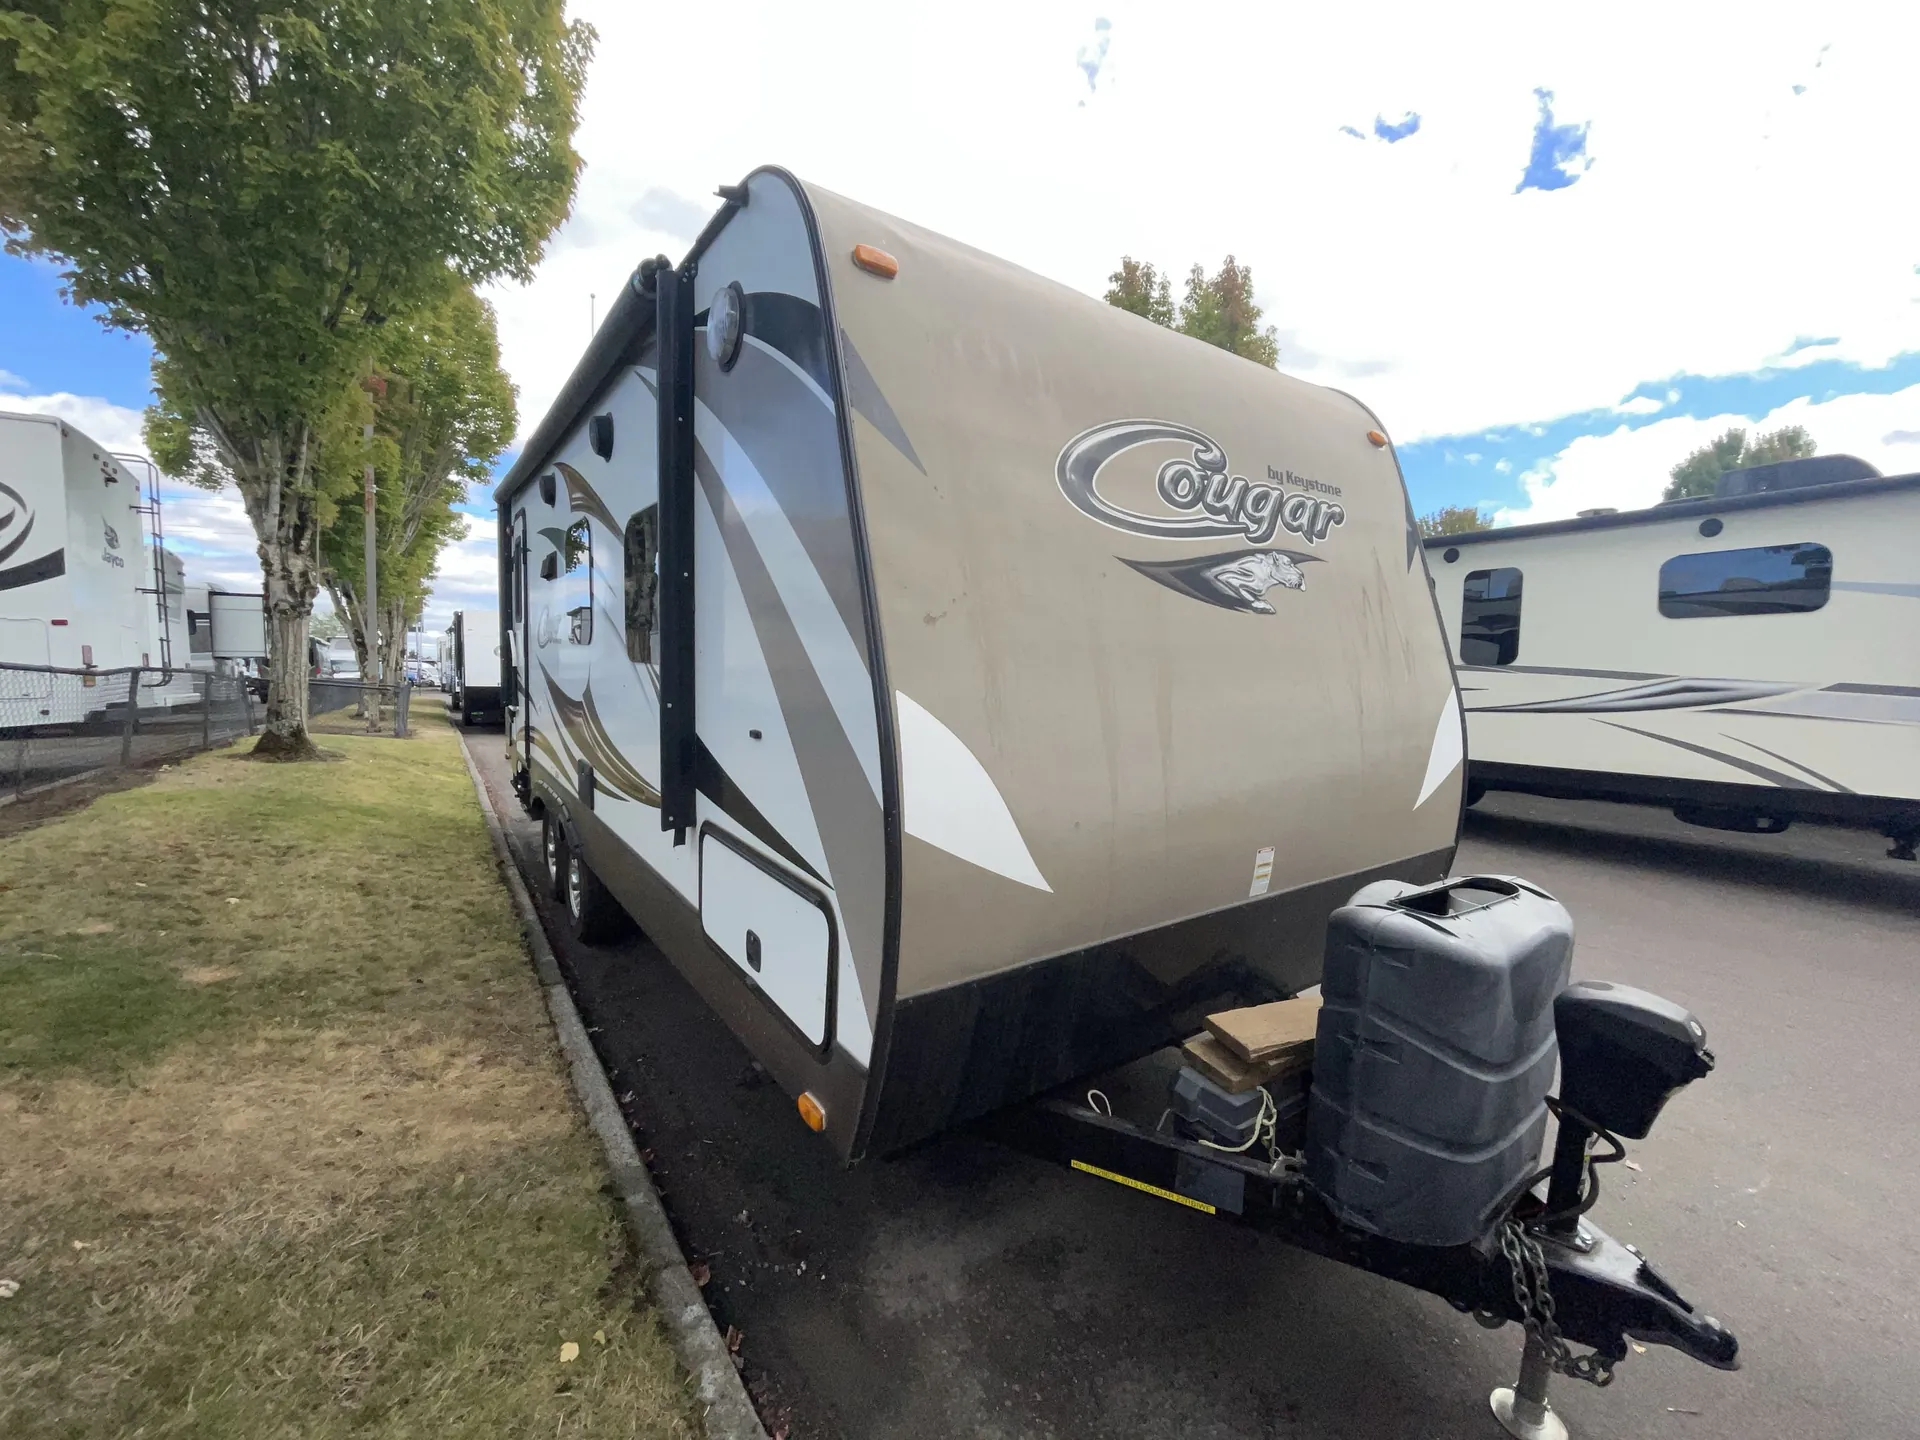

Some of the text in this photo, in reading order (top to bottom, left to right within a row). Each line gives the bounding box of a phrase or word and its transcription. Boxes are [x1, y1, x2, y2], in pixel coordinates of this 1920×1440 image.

[1055, 418, 1346, 546] Cougar
[1267, 465, 1342, 497] by Keystone
[101, 547, 125, 568] Jayco
[1140, 1182, 1175, 1200] COUGAR
